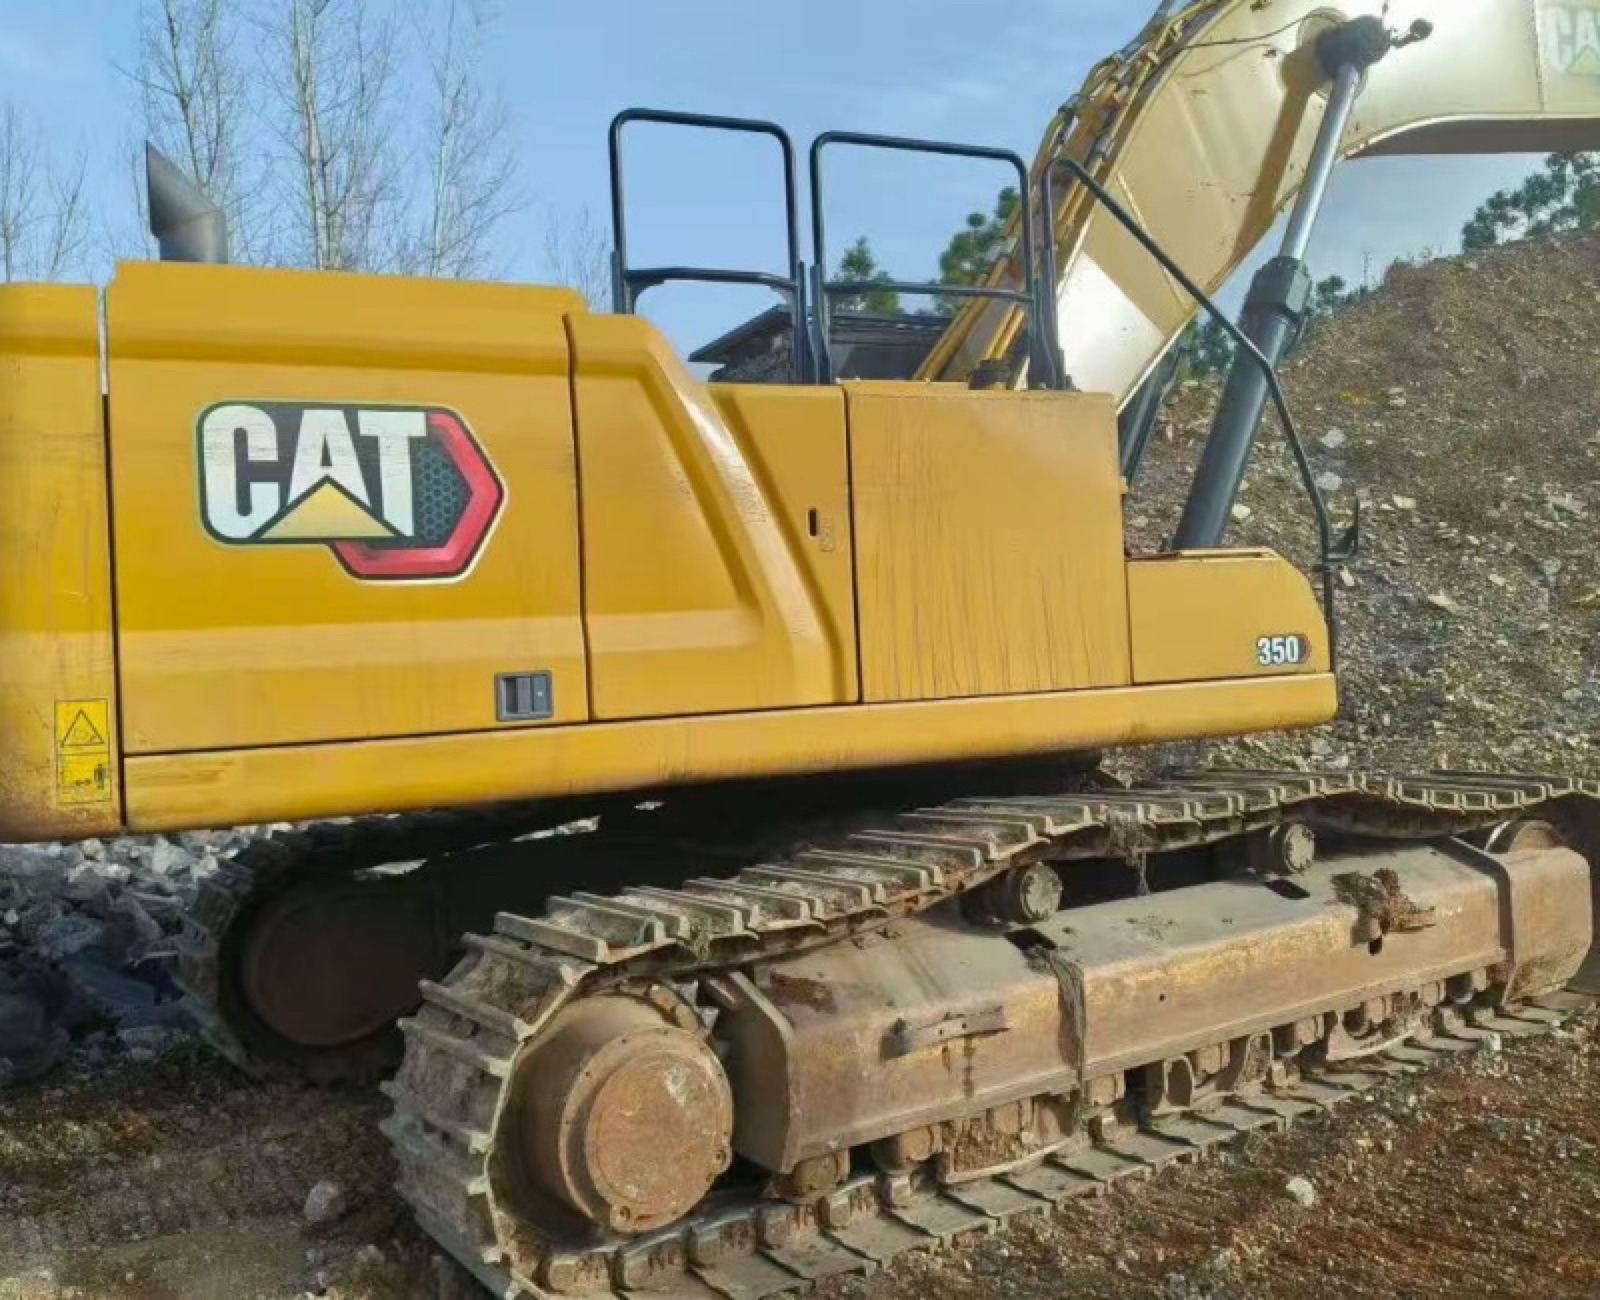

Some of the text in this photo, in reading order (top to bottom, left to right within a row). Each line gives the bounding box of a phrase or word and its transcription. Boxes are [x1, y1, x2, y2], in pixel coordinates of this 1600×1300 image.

[1545, 7, 1600, 73] CA
[203, 405, 427, 539] CAT
[1257, 635, 1299, 665] 350
